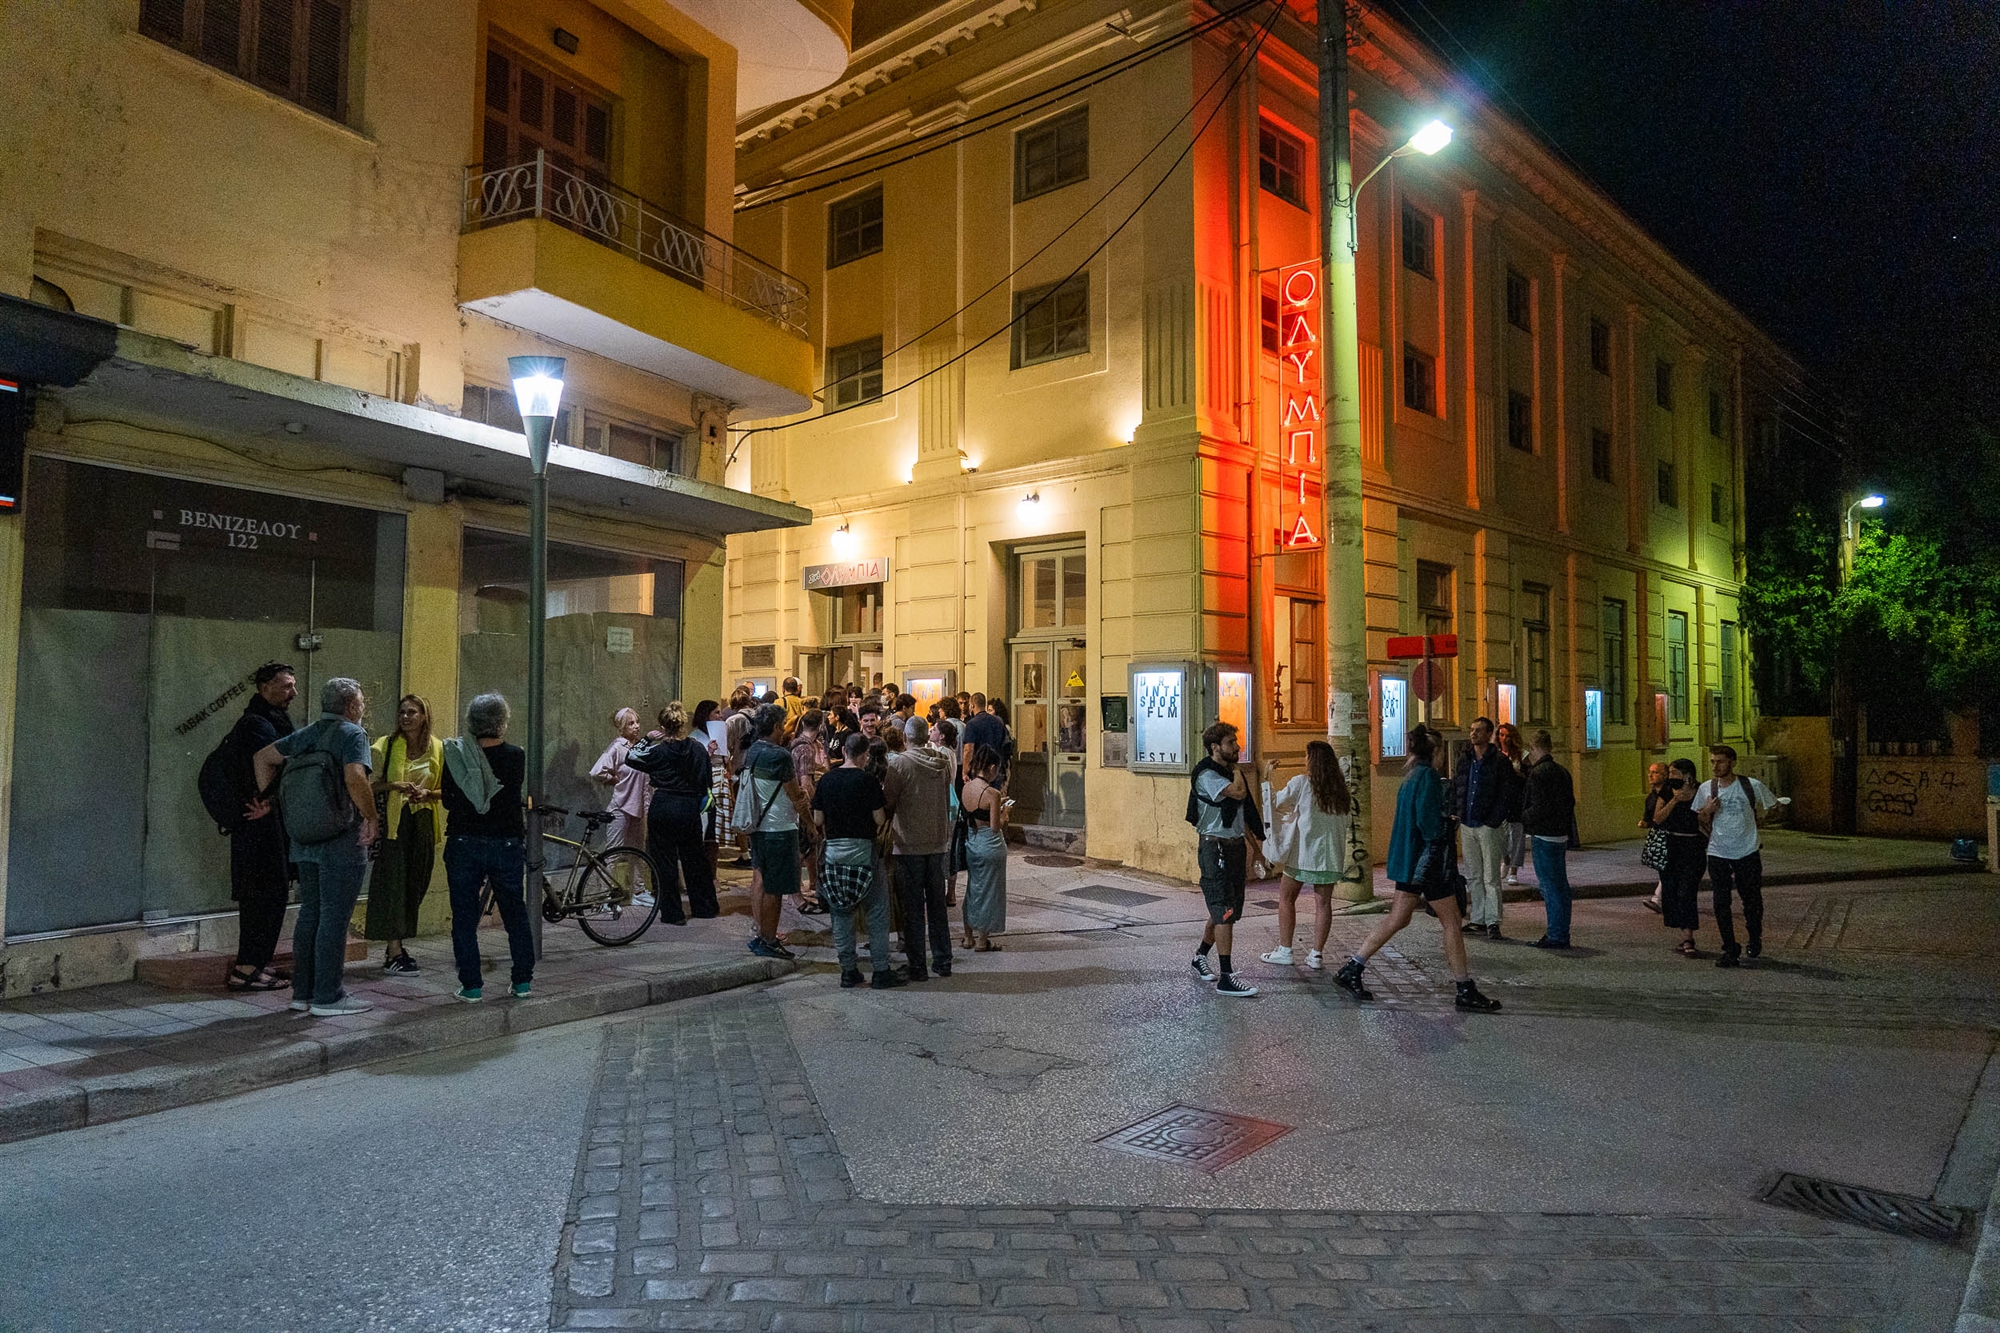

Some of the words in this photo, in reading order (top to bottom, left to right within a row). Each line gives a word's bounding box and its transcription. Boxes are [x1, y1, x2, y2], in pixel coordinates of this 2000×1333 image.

[1284, 269, 1320, 546] ΟΛΥΜΠΙΑ
[179, 509, 302, 540] ΒΕΝΙΖΕΛΟΥ
[227, 533, 260, 550] 122
[820, 562, 880, 586] ΟΛΥΜΠΙΑ
[1145, 685, 1180, 697] INTL
[174, 708, 212, 736] TABAK
[208, 681, 247, 713] COFFEE
[1147, 706, 1178, 718] FLM
